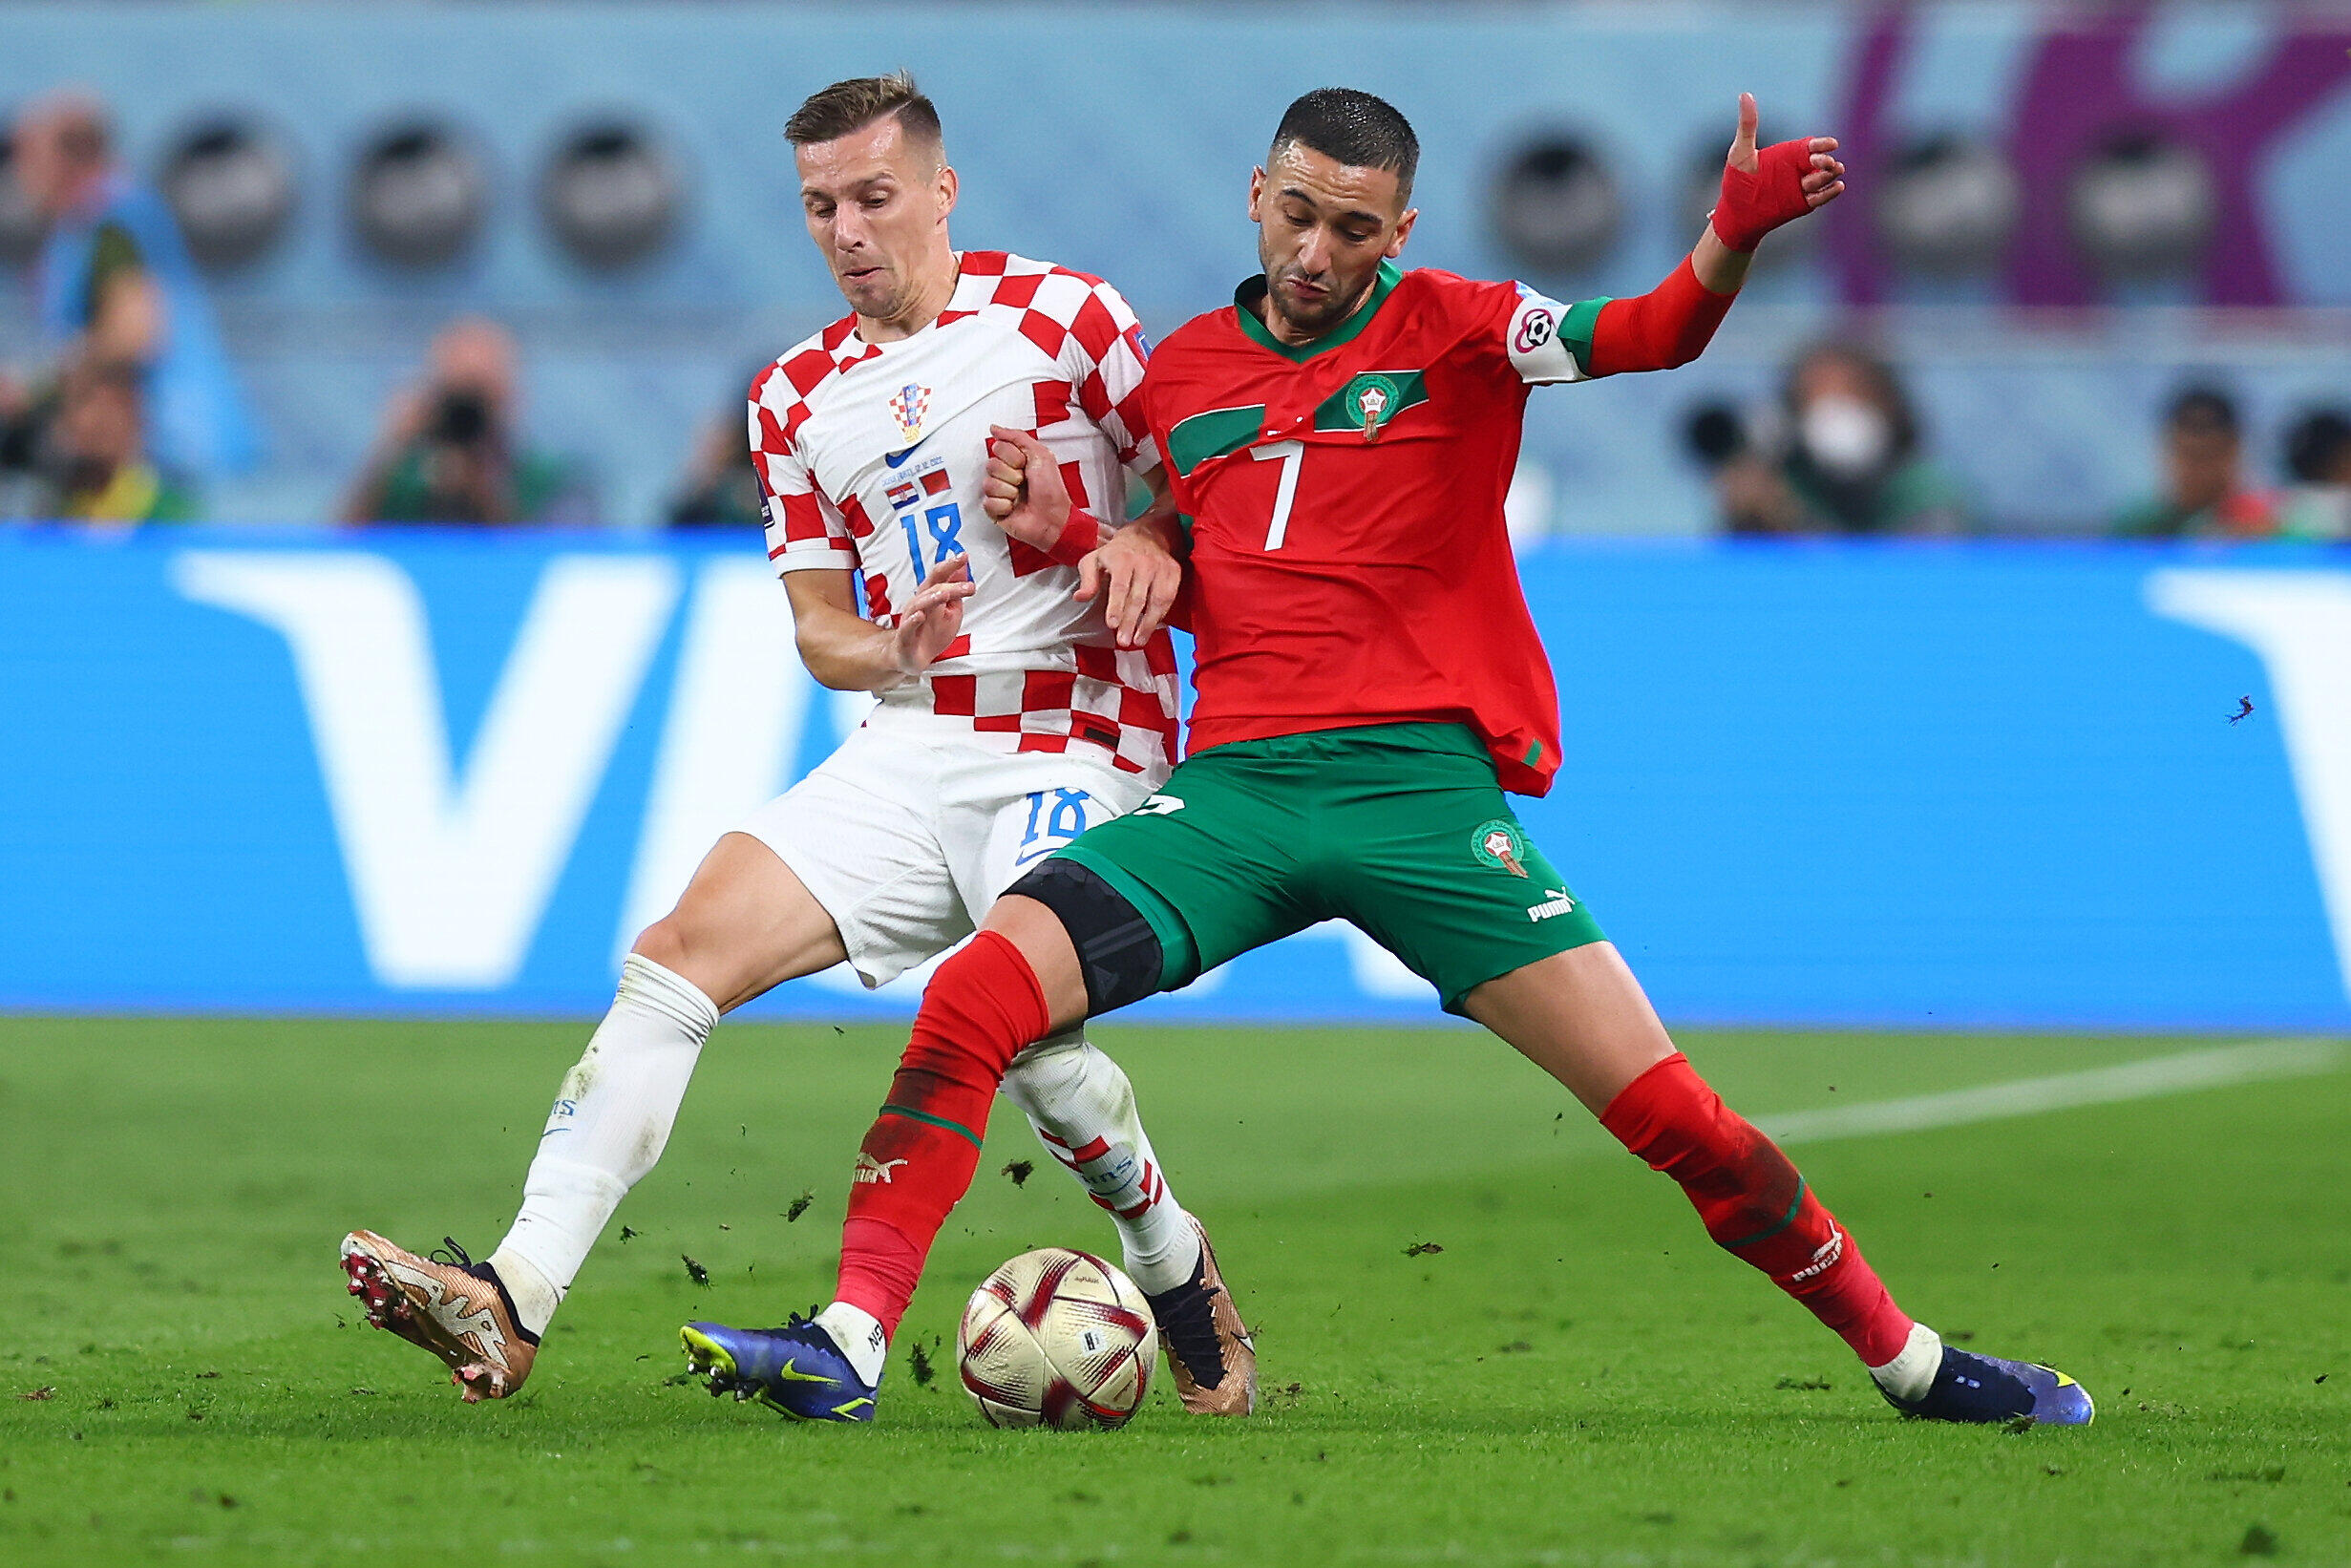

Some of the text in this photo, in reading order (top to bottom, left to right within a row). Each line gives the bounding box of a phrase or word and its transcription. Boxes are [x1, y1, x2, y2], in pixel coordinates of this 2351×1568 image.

[1250, 438, 1304, 552] 7
[900, 502, 975, 595] 18
[1019, 787, 1087, 848] 18
